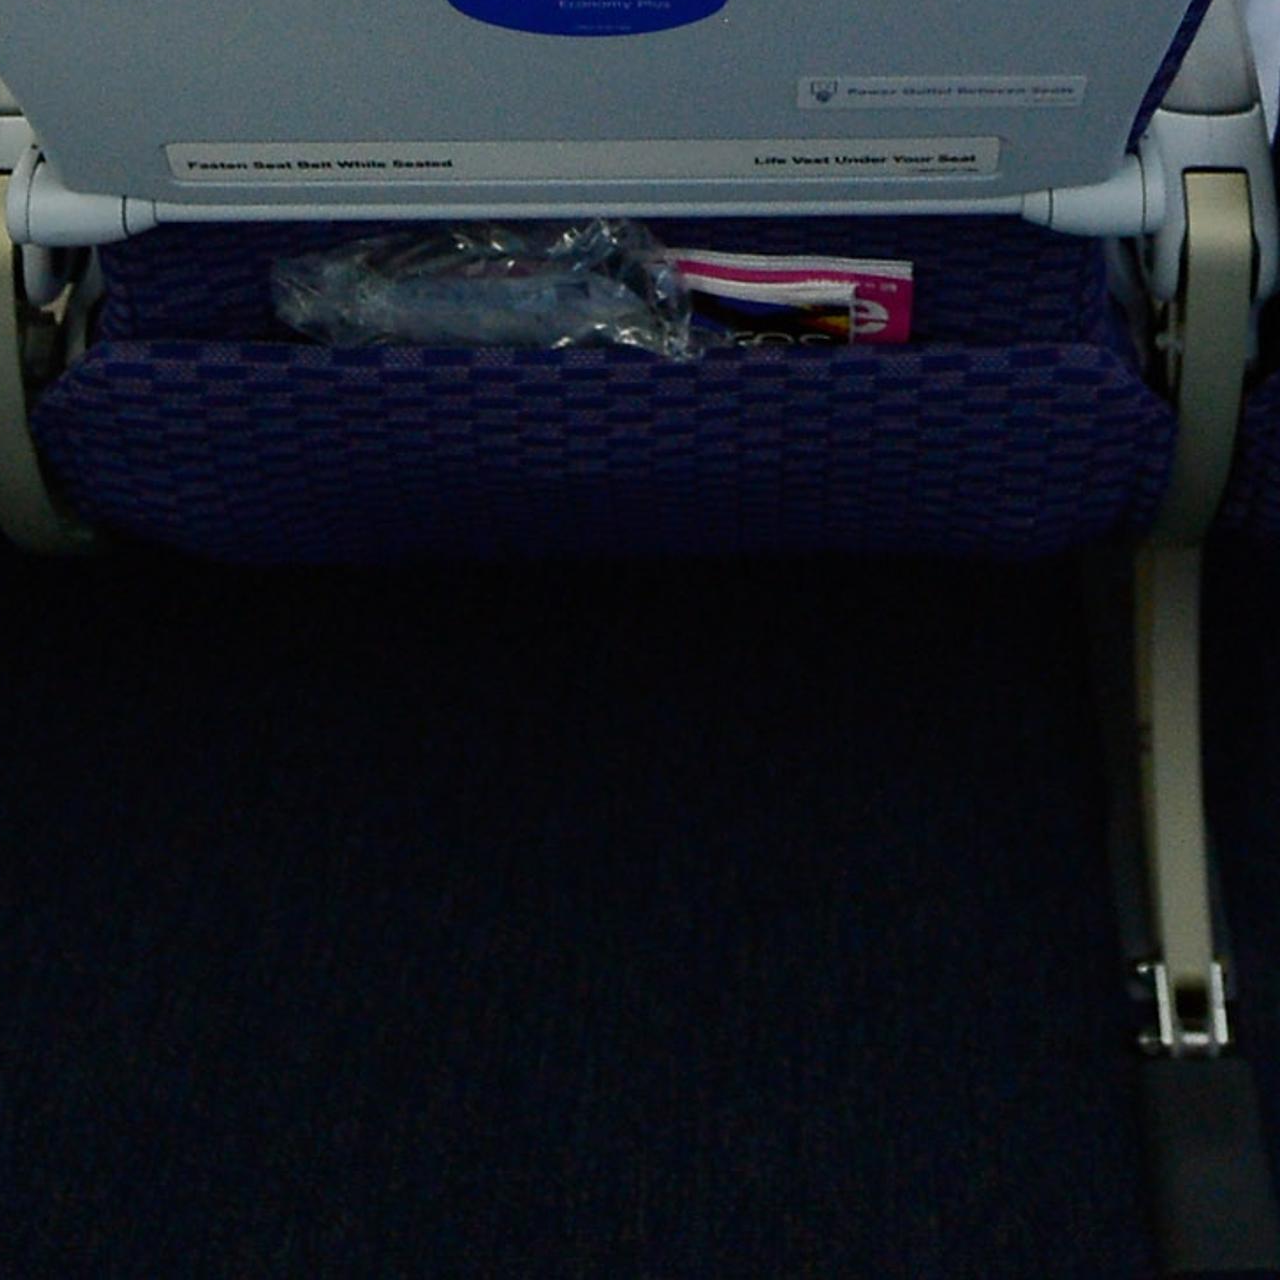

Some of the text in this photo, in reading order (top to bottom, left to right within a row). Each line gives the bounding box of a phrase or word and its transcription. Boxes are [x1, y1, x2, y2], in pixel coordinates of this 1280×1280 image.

[558, 0, 631, 10] Economy
[187, 159, 453, 170] Fasten Seat Belt While Seated
[754, 153, 977, 165] Life Vest Under Your Seat
